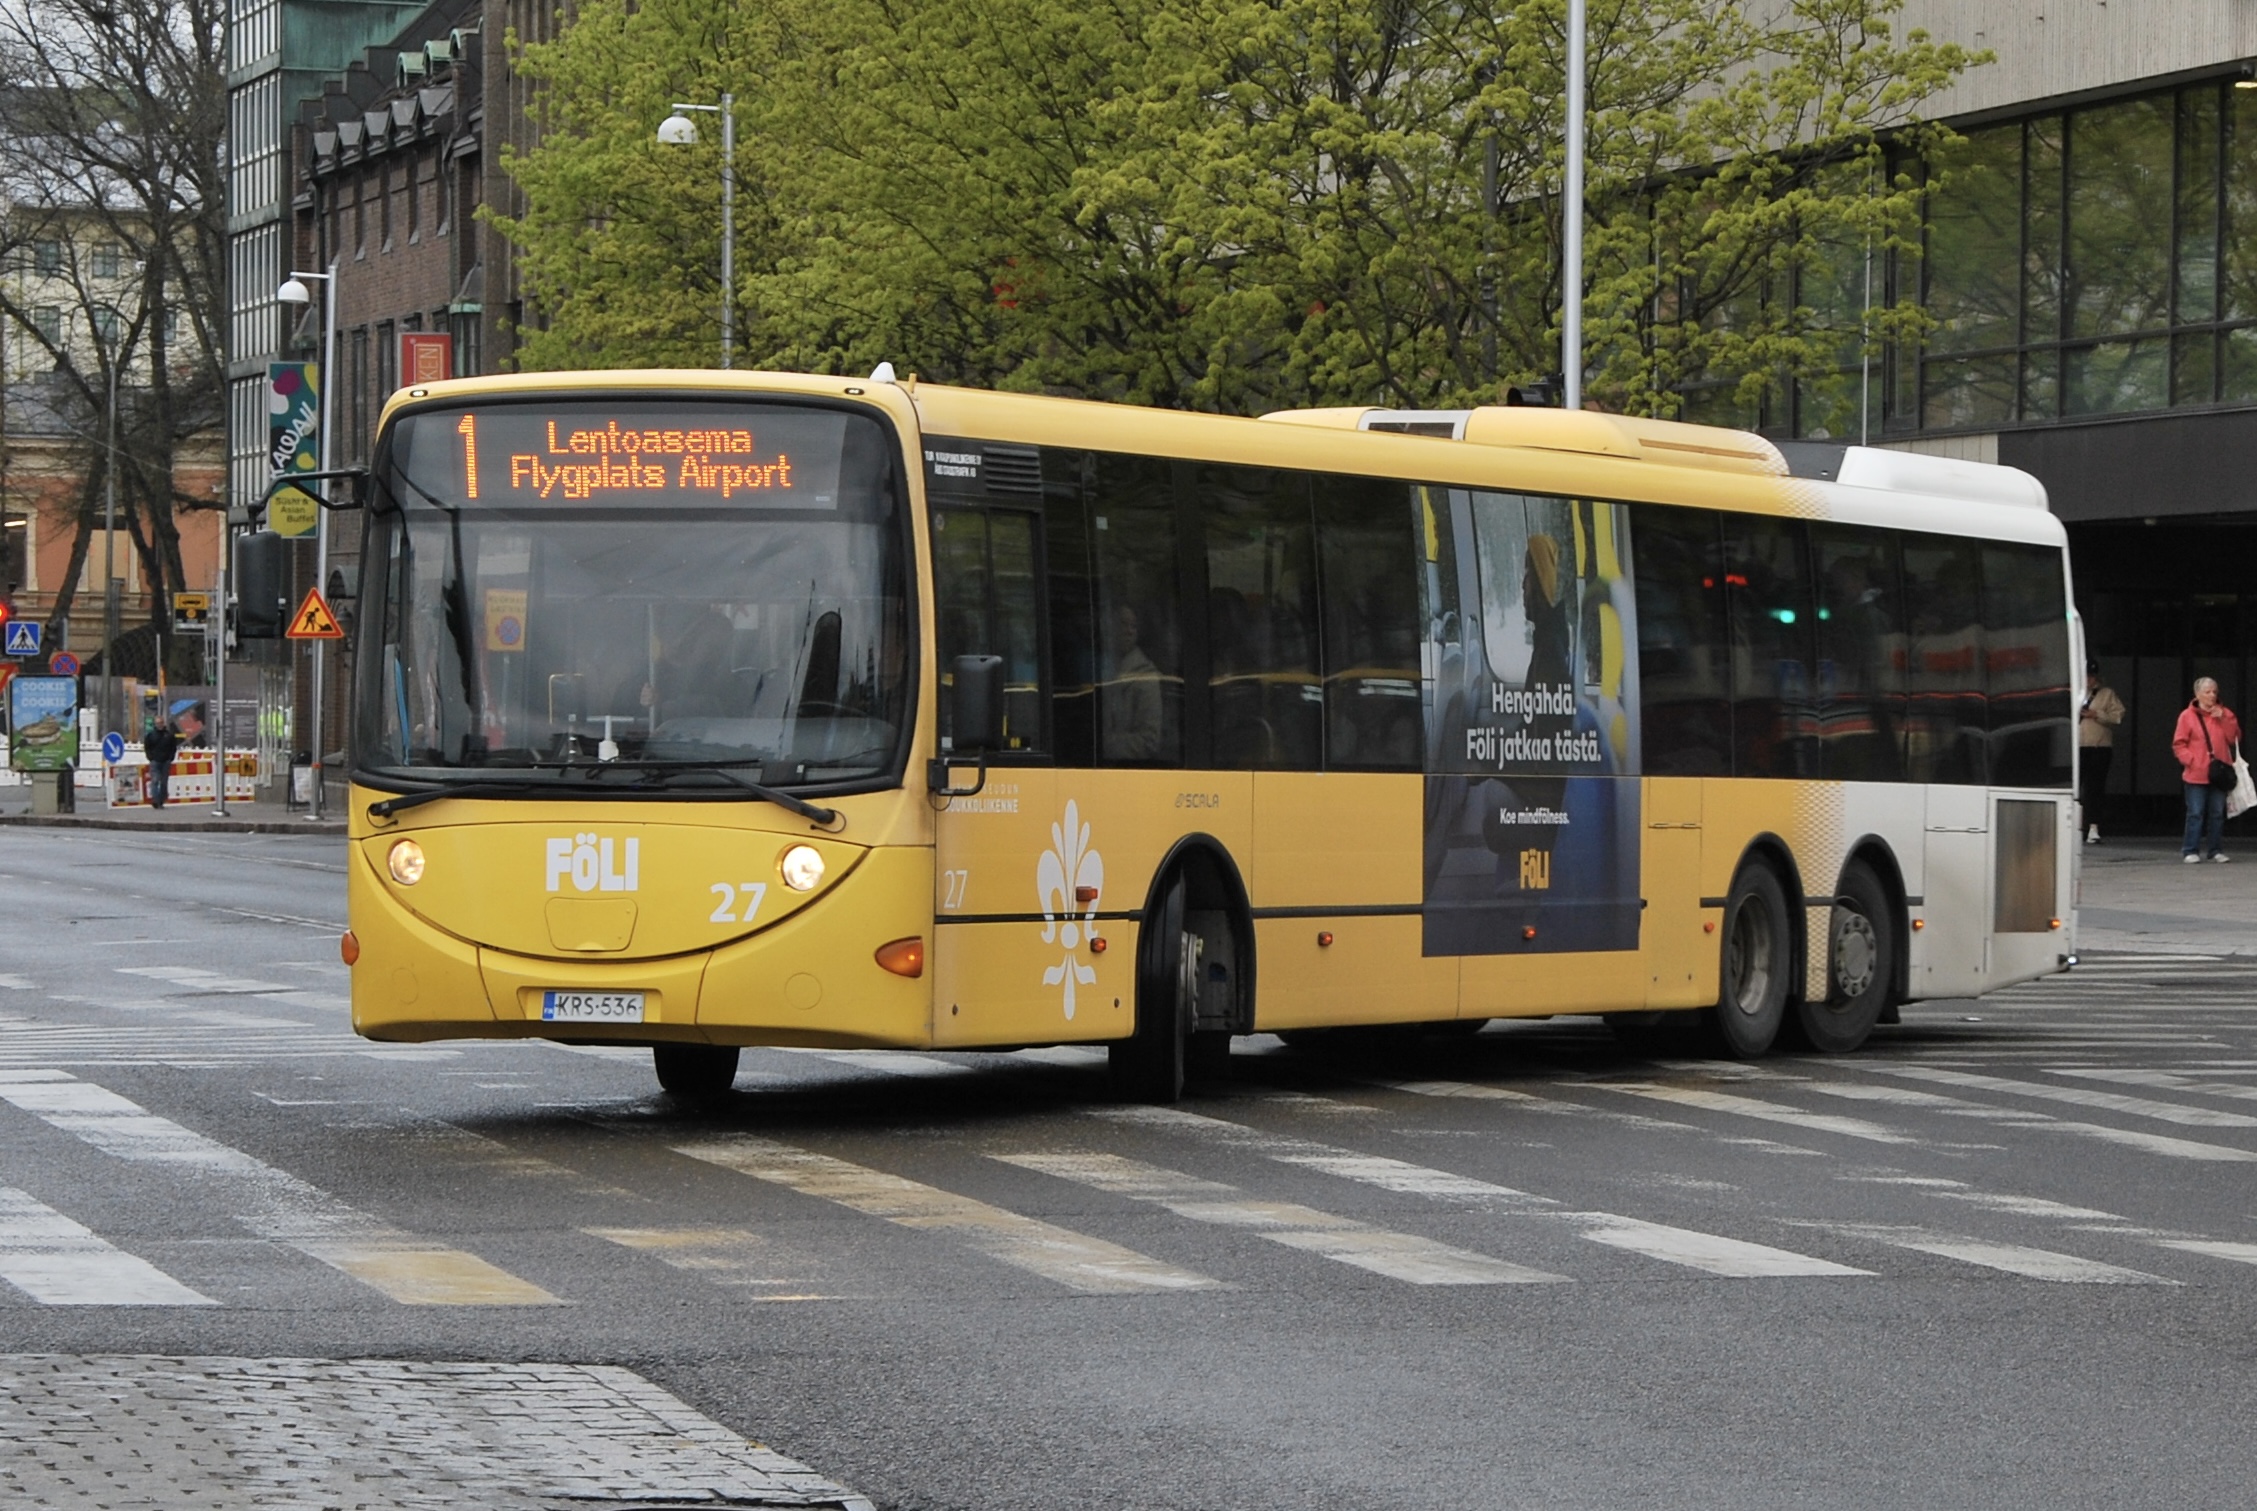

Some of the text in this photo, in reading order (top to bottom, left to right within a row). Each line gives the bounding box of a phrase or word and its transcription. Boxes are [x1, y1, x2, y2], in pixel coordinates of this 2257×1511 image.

[458, 414, 477, 498] 1
[547, 420, 752, 454] Lentoasema
[511, 454, 792, 498] Flygplats Airport
[286, 515, 315, 523] Buffet
[1492, 682, 1577, 724] Hengähdä.
[1466, 727, 1602, 770] Föli jatkaa tästä.
[1500, 807, 1517, 825] Koe
[545, 832, 639, 891] FÖLI
[1520, 847, 1549, 889] FÖLI
[709, 882, 767, 923] 27
[944, 869, 968, 909] 27
[557, 995, 638, 1016] KRS-536
